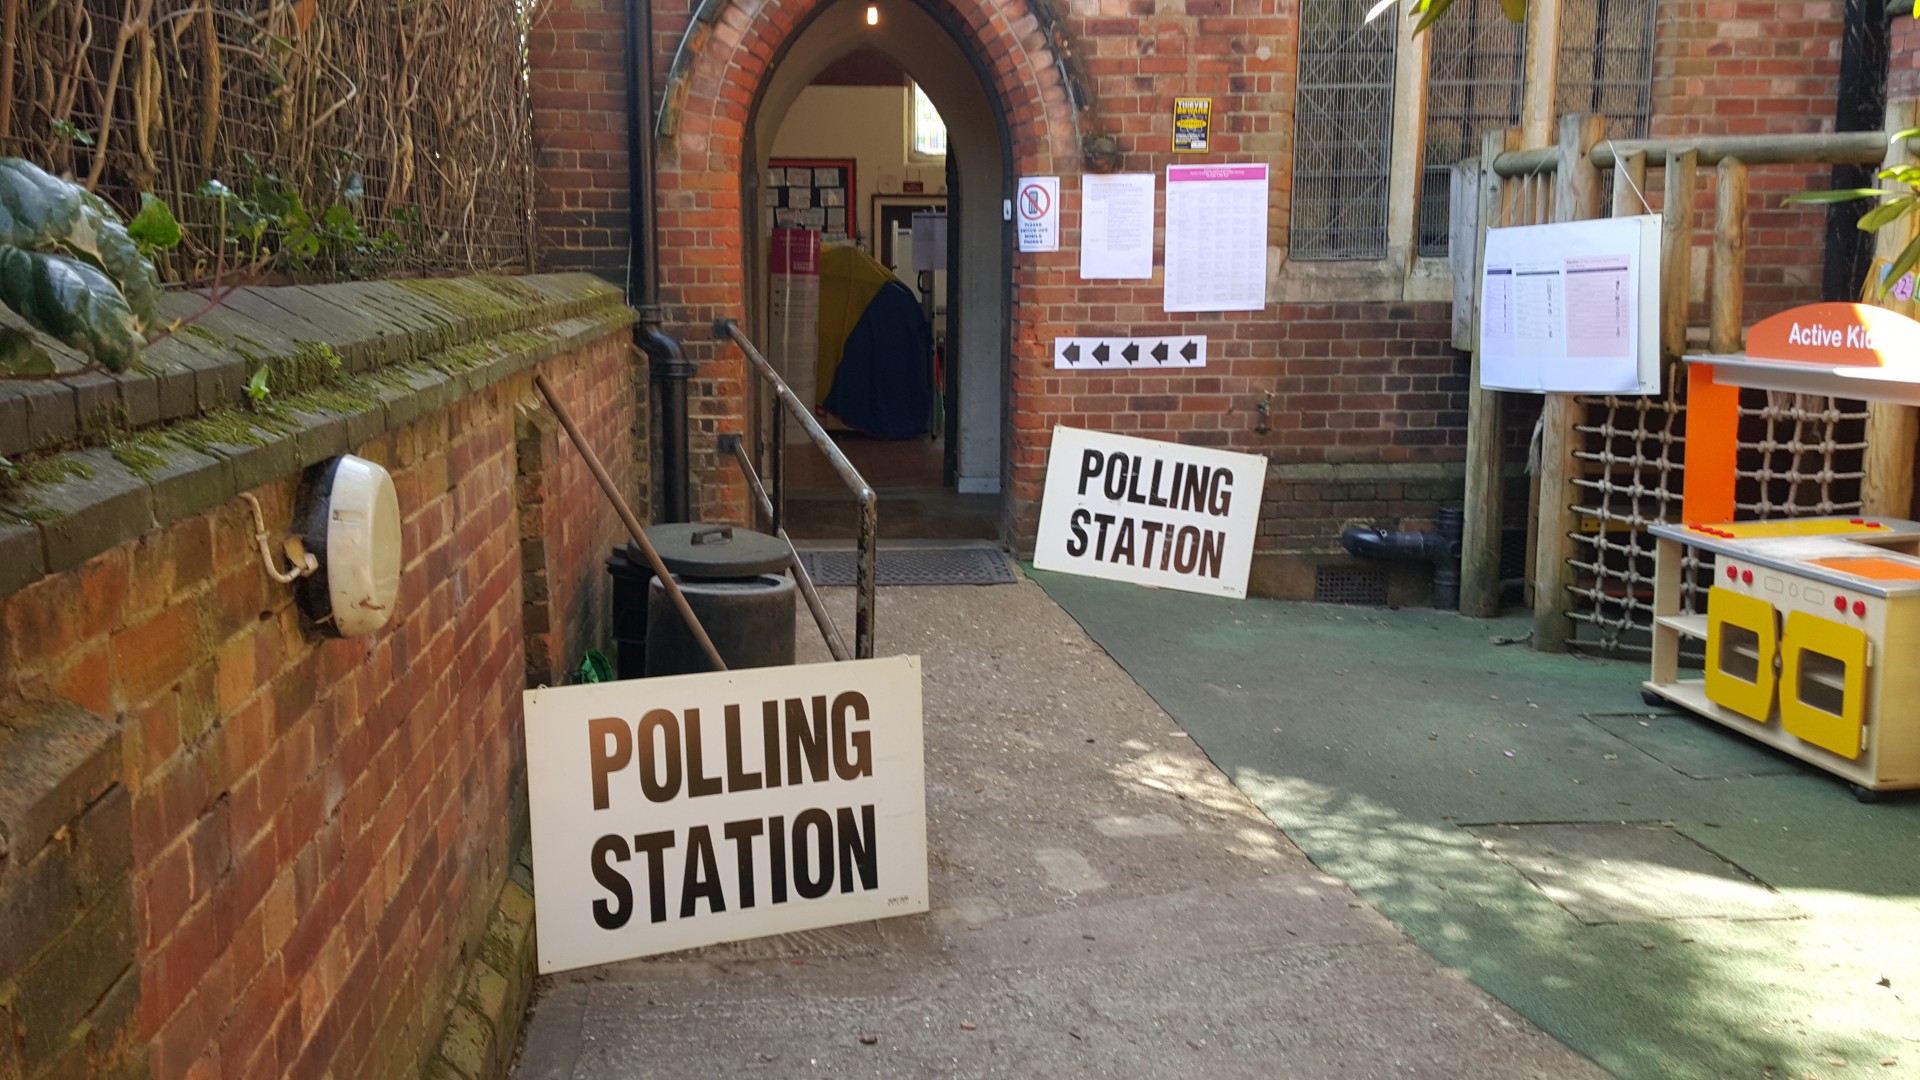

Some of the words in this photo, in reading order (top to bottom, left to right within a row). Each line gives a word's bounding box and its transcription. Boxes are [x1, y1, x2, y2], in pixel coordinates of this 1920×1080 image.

[1788, 322, 1842, 348] Active
[1077, 449, 1234, 517] POLLING
[1066, 508, 1226, 579] STATION
[588, 690, 874, 811] POLLING
[590, 803, 879, 931] STATION
